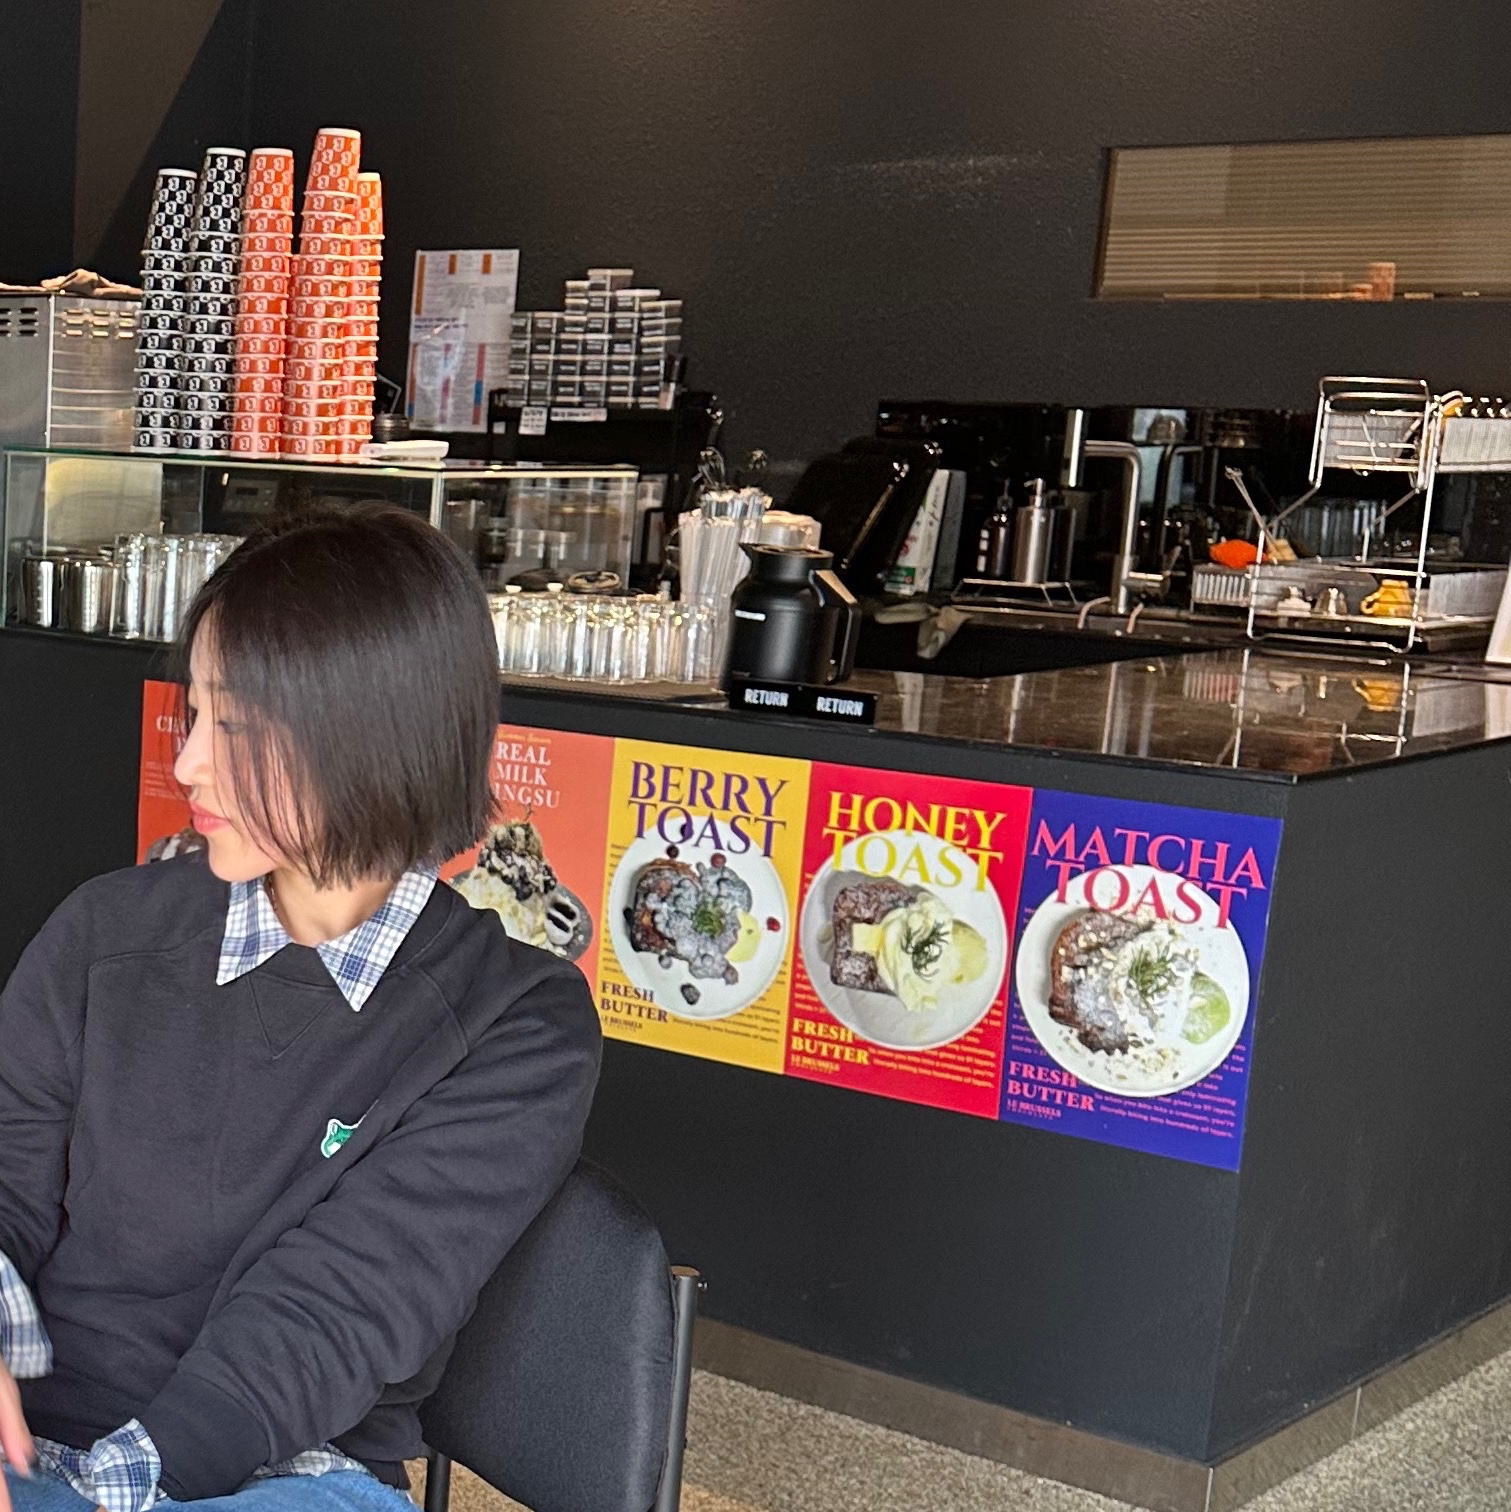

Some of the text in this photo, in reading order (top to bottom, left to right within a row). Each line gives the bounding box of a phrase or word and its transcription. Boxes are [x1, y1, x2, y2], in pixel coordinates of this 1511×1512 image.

[744, 688, 789, 707] RETURN
[816, 696, 864, 717] RETURN
[494, 741, 551, 766] REAL
[494, 762, 547, 786] MILK
[493, 782, 560, 808] INGSU
[630, 760, 789, 817] BERRY
[628, 799, 787, 859] TOAST
[828, 791, 1007, 849] HONEY
[823, 827, 1004, 892] TOAST
[1031, 818, 1267, 889] MATCHA
[1045, 859, 1248, 929] TOAST
[601, 980, 654, 1002] FRESH
[601, 997, 668, 1023] BUTTER
[792, 1017, 853, 1043] FRESH
[791, 1035, 869, 1065] BUTTER
[1009, 1060, 1077, 1088] FRESH
[1007, 1079, 1095, 1112] BUTTER
